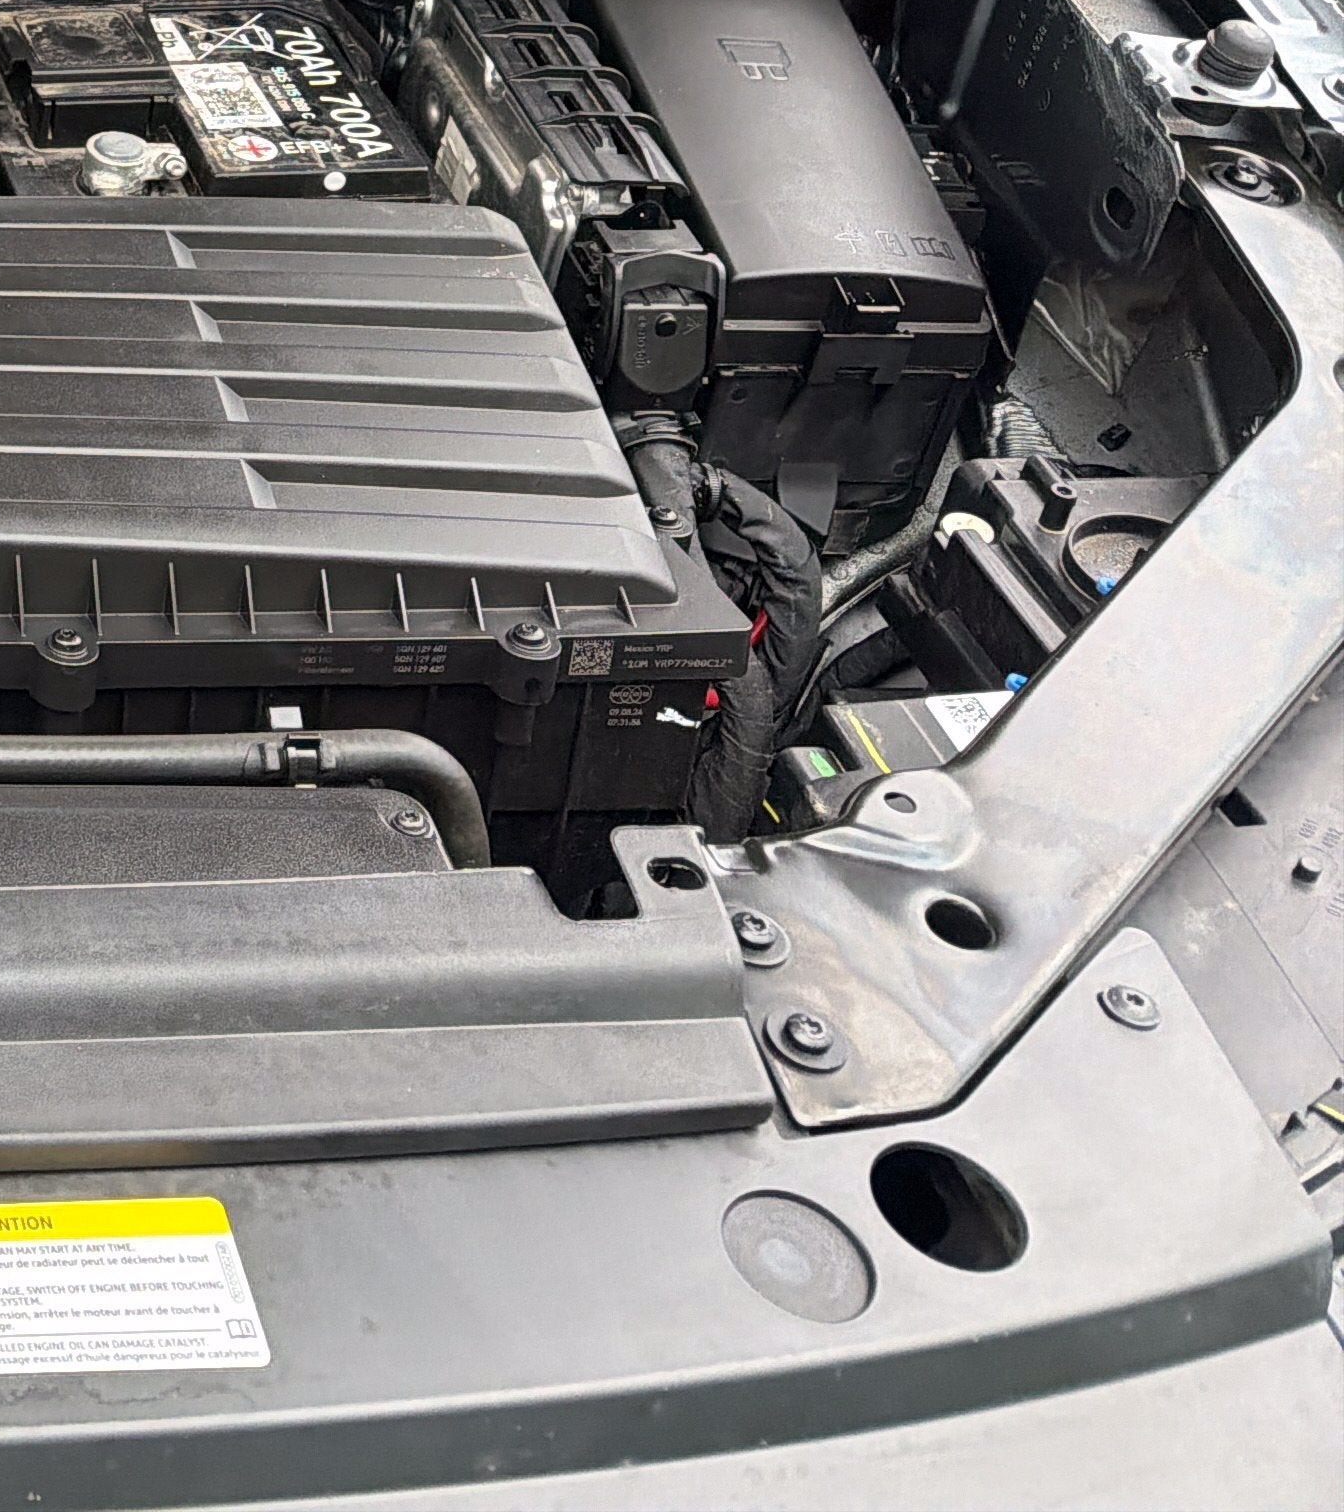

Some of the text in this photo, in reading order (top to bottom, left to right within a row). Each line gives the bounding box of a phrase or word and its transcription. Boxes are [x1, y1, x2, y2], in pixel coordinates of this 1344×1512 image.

[156, 31, 179, 47] Pb
[275, 26, 393, 159] 70Ah 700A
[279, 140, 346, 155] EFB+
[16, 1246, 37, 1255] MAY
[39, 1245, 69, 1254] START
[72, 1244, 83, 1252] AT
[86, 1244, 106, 1252] ANY
[16, 1259, 28, 1268] de
[32, 1258, 78, 1267] radiateur
[81, 1256, 105, 1268] peut
[107, 1257, 118, 1265] se
[121, 1255, 175, 1264] déclencher
[179, 1253, 185, 1263] à
[187, 1254, 209, 1262] tout
[27, 1285, 65, 1295] SWITCH
[68, 1285, 86, 1293] OFF
[90, 1284, 127, 1293] ENGINE
[130, 1283, 170, 1292] BEFORE
[171, 1281, 224, 1291] TOUCHING
[34, 1309, 69, 1318] arrêter
[71, 1308, 81, 1317] le
[84, 1308, 121, 1317] moteur
[124, 1307, 153, 1316] avant
[156, 1306, 168, 1315] de
[171, 1305, 210, 1315] toucher
[214, 1304, 220, 1313] à
[28, 1342, 65, 1351] ENGINE
[68, 1340, 85, 1350] OIL
[88, 1340, 109, 1349] CAN
[112, 1339, 155, 1348] DAMAGE
[170, 1350, 193, 1361] pour
[196, 1350, 206, 1359] le
